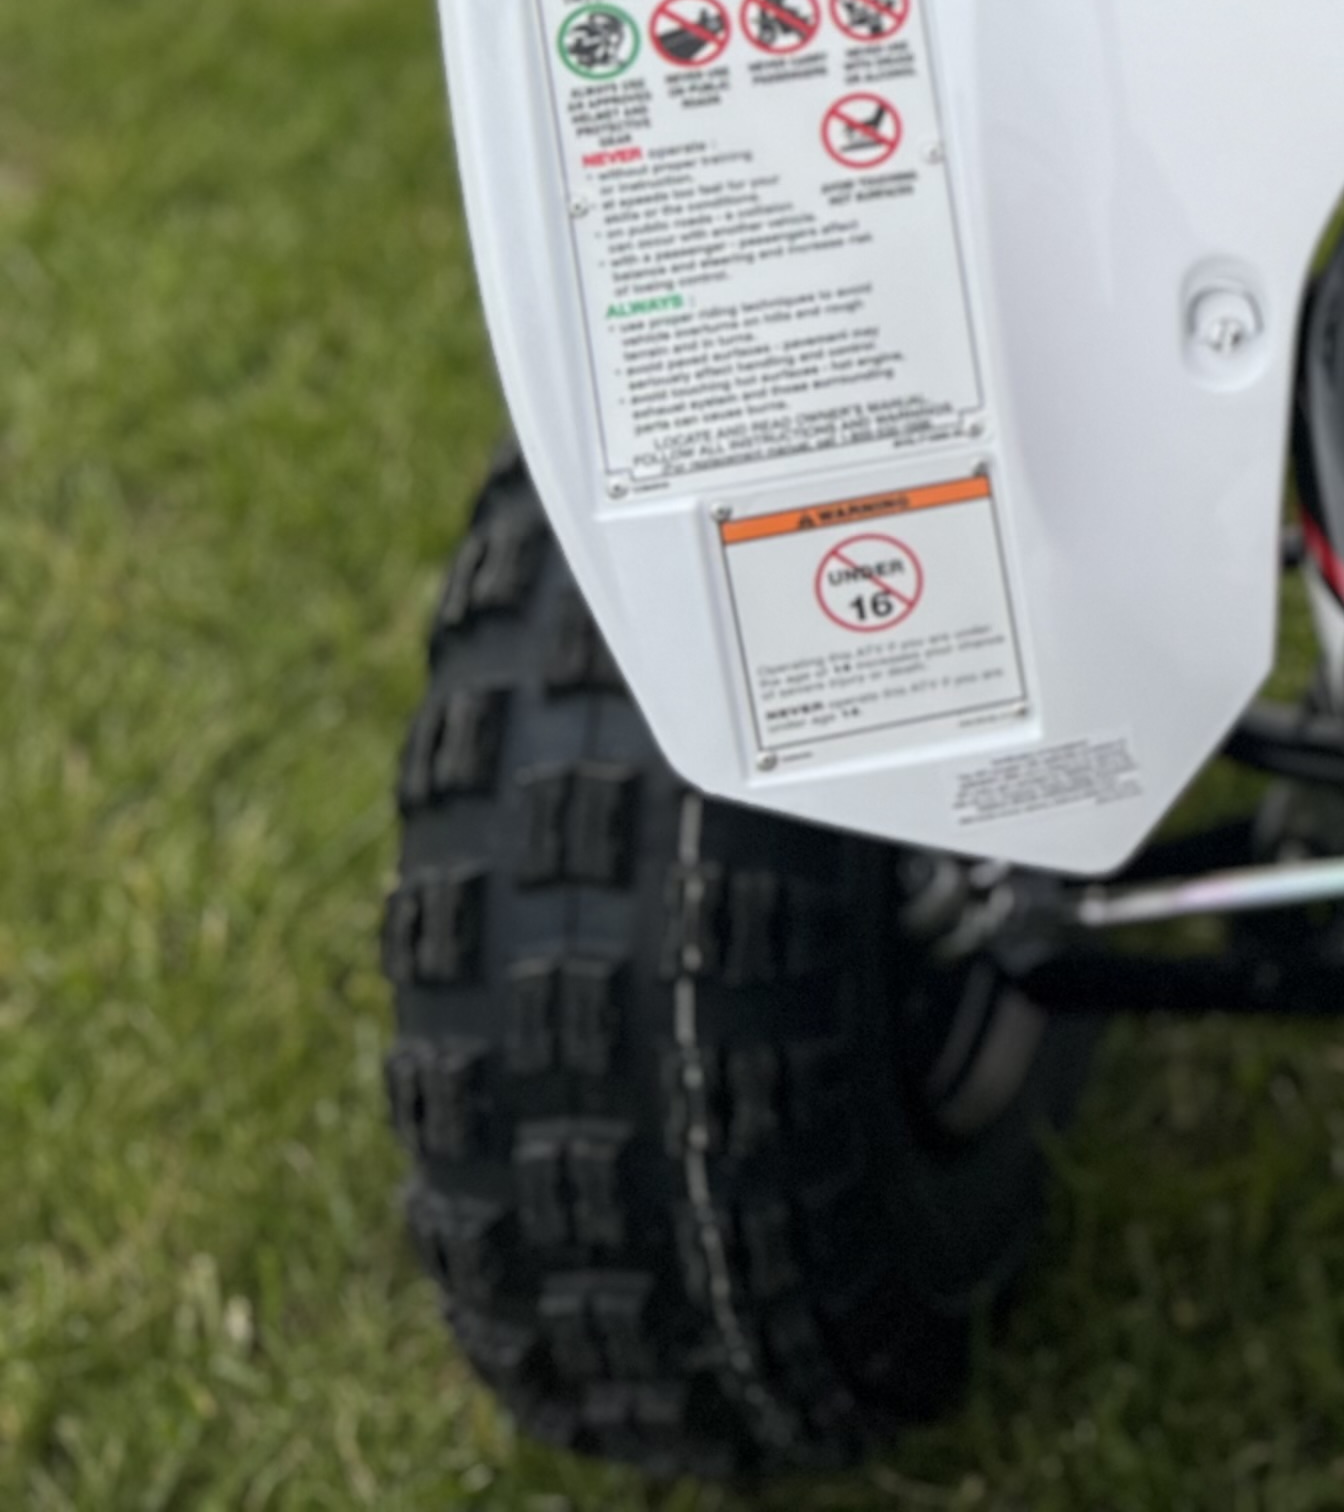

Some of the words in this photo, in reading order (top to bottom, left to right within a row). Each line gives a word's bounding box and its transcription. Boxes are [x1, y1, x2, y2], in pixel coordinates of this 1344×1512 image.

[581, 146, 642, 167] NEVER
[605, 293, 684, 318] ALWAYS
[817, 494, 909, 521] WARNING
[826, 557, 906, 587] UNDER
[848, 589, 895, 623] 16
